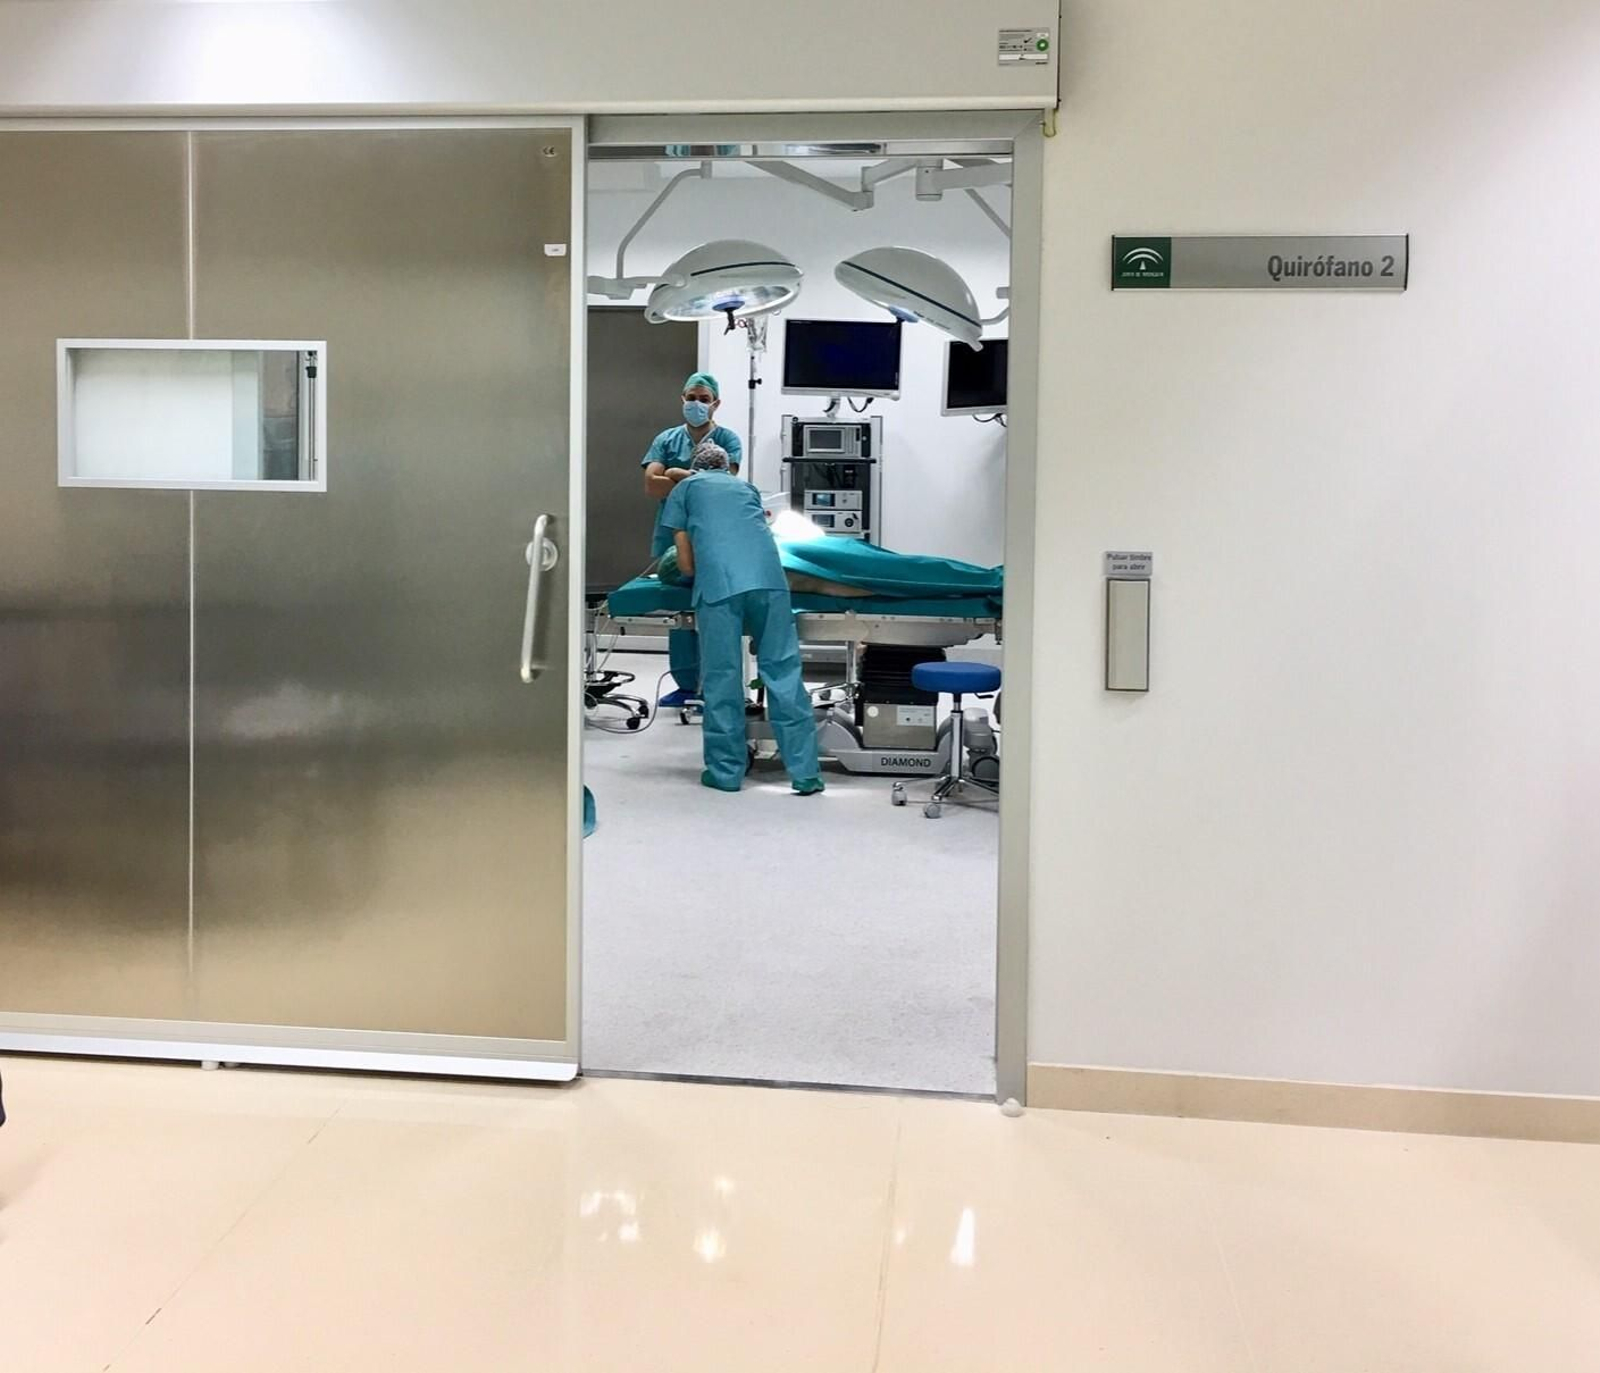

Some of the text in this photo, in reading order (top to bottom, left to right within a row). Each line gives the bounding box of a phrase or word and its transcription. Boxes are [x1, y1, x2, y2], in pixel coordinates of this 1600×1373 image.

[1267, 255, 1395, 282] Quirófano 2
[881, 757, 931, 768] DIAMOND
